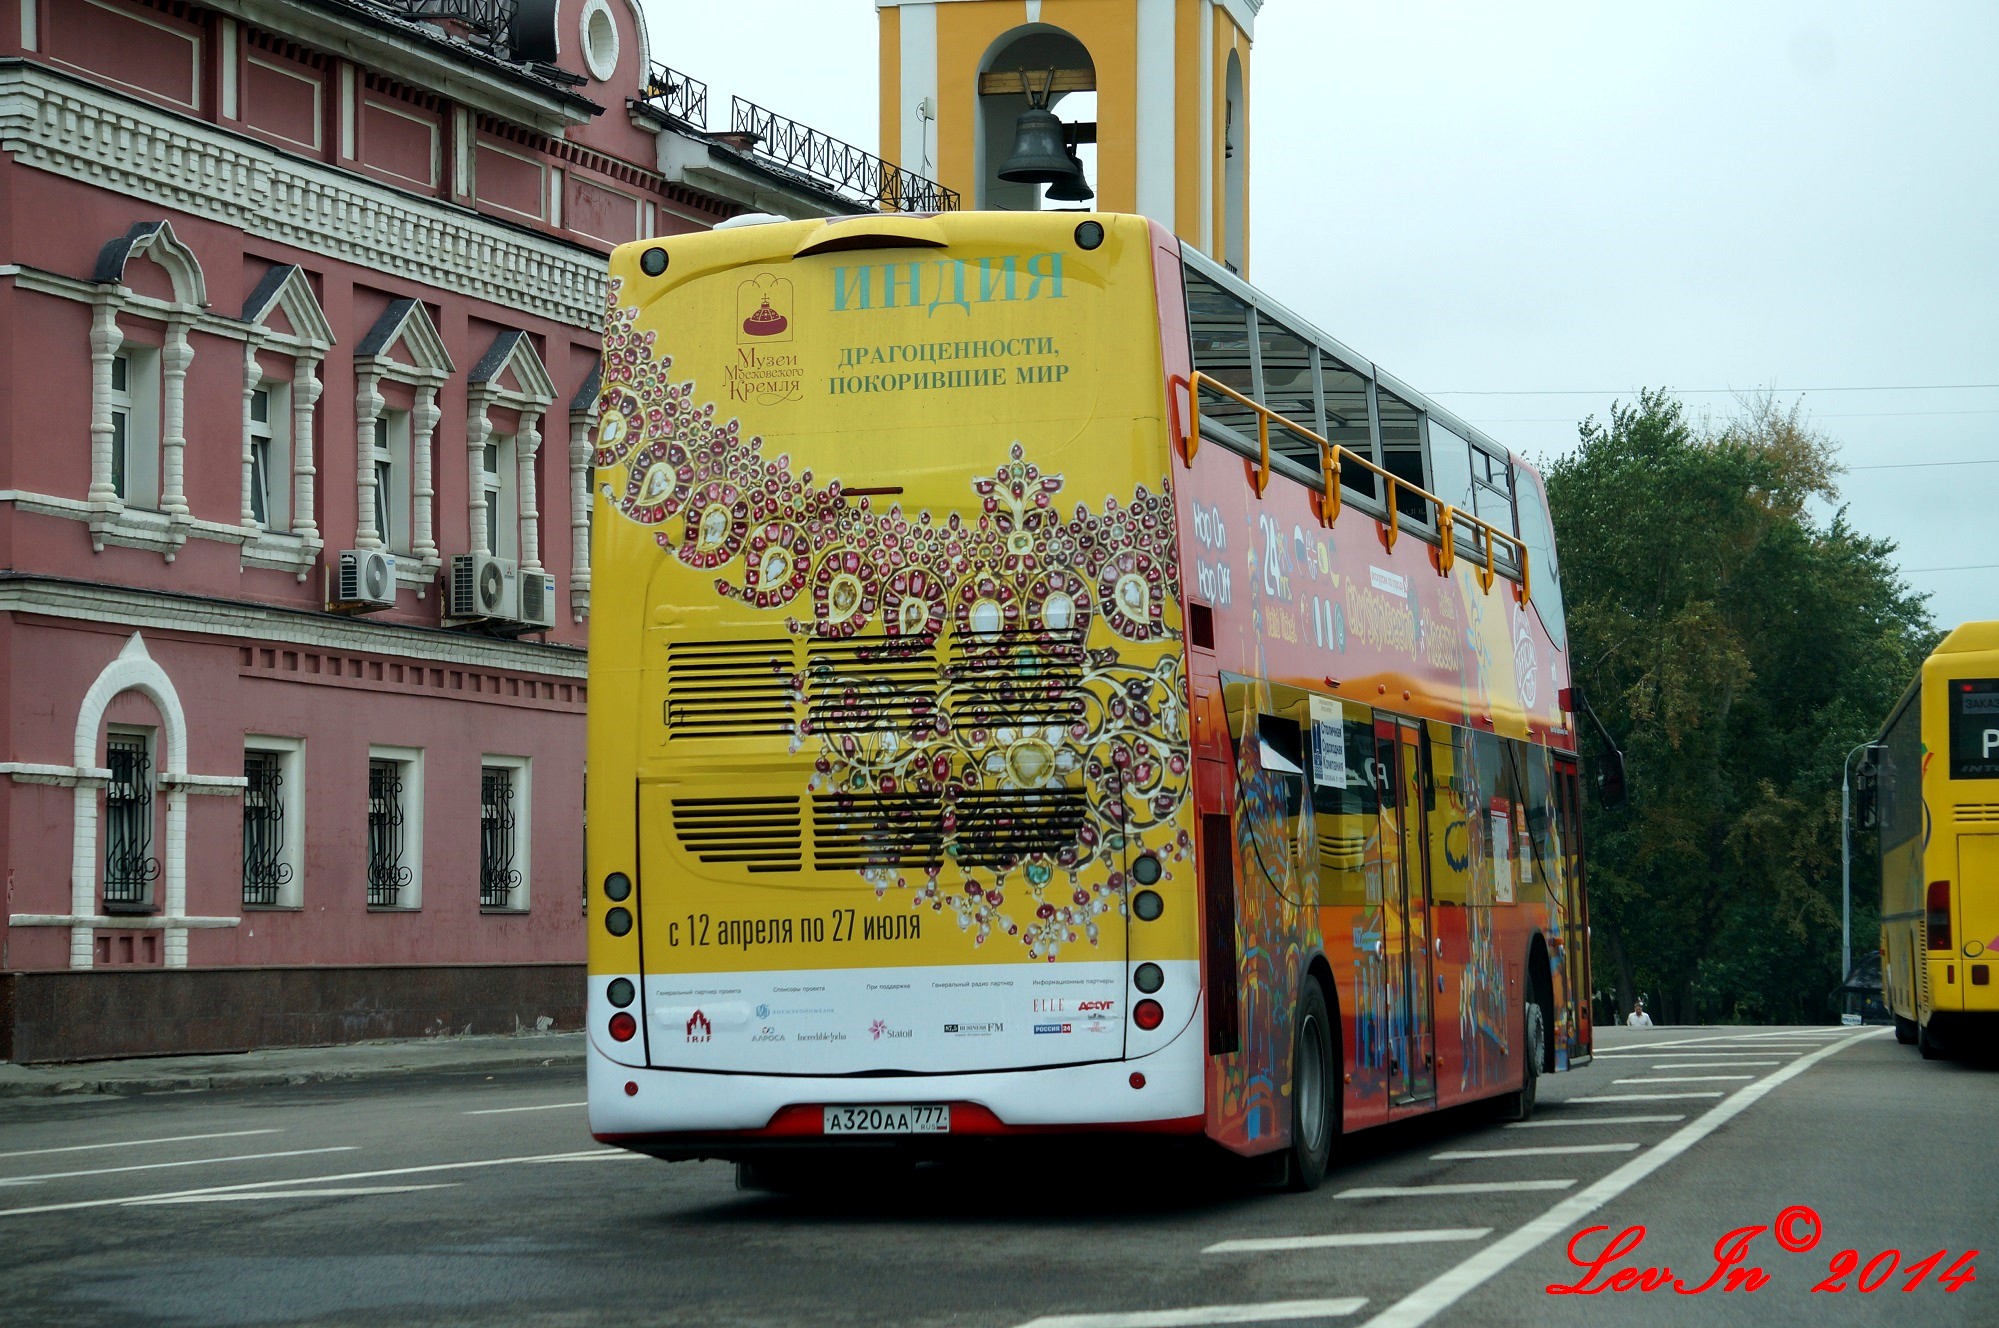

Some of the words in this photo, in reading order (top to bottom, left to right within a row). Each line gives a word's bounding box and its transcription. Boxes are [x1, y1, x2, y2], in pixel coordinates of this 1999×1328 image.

[829, 252, 1068, 318] ИНДИЯ
[738, 348, 797, 371] Музеи
[838, 336, 1059, 370] ДРАГОЦЕННОСТИ,
[722, 365, 804, 387] Московского
[829, 368, 1006, 395] ПОКОРИВШИЕ
[1015, 364, 1069, 385] МИР
[730, 380, 803, 406] Кремля
[1193, 502, 1212, 549] Hop
[1212, 506, 1227, 549] On
[1197, 559, 1216, 606] Hop
[1217, 562, 1231, 605] Off
[669, 922, 679, 946] с
[687, 914, 710, 946] 12
[718, 919, 793, 951] апреля
[801, 918, 824, 943] по
[832, 909, 856, 941] 27
[864, 914, 921, 941] июля
[1033, 998, 1064, 1013] ELLE
[1078, 1000, 1114, 1011] ДОСУГ
[887, 1029, 913, 1039] Statoil
[988, 1022, 1004, 1032] FM
[1035, 1025, 1060, 1033] РОССИЯ
[1062, 1024, 1071, 1032] 24
[913, 1106, 943, 1124] 777
[920, 1123, 936, 1131] RUS
